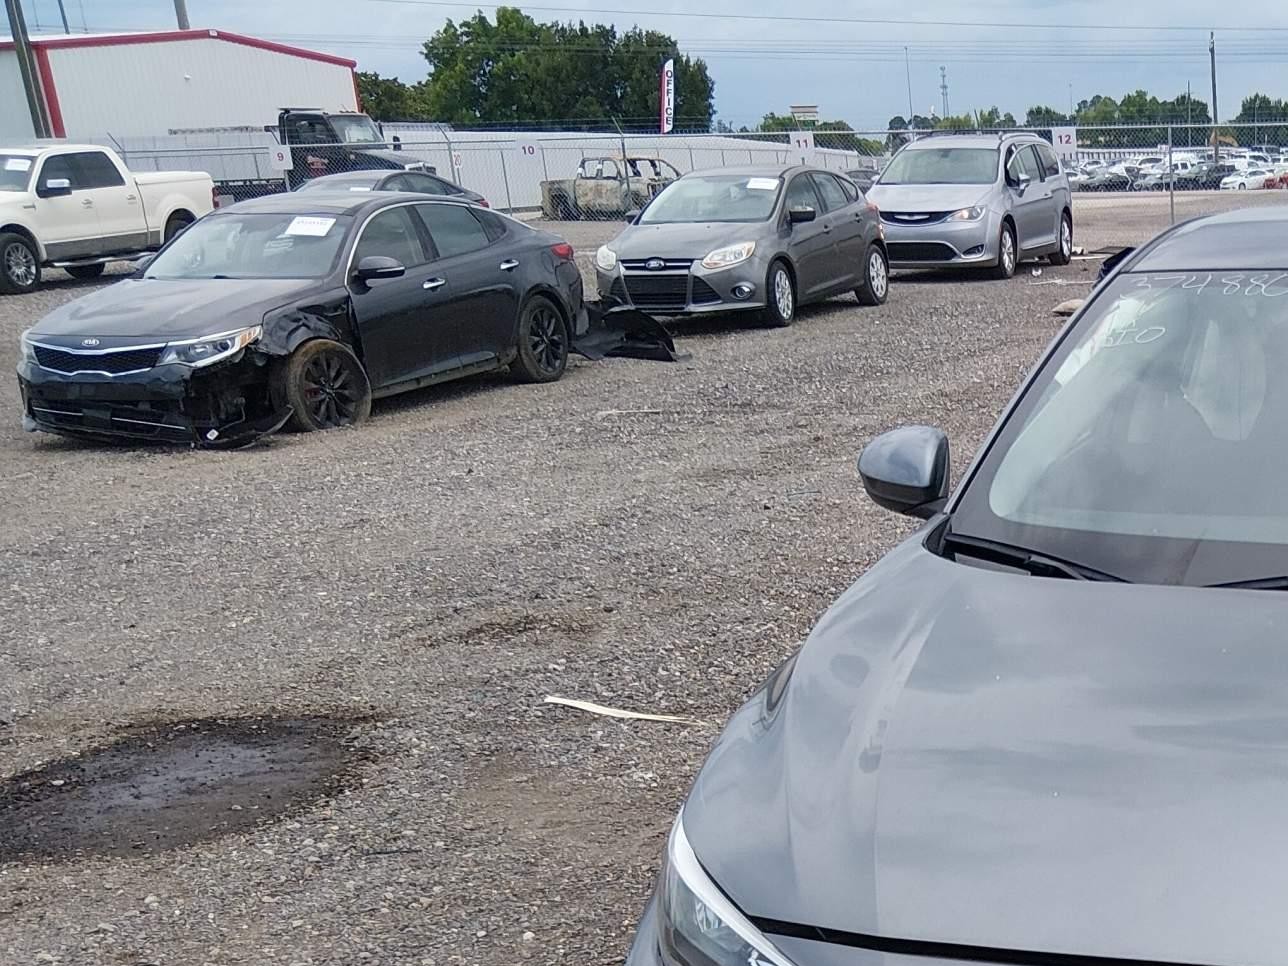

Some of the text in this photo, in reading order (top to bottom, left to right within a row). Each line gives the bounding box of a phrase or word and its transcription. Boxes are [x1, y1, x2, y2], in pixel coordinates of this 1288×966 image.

[665, 70, 673, 126] OFFICE
[795, 138, 808, 149] 11
[1058, 134, 1072, 144] 12
[522, 145, 535, 155] 10
[277, 152, 284, 161] 9
